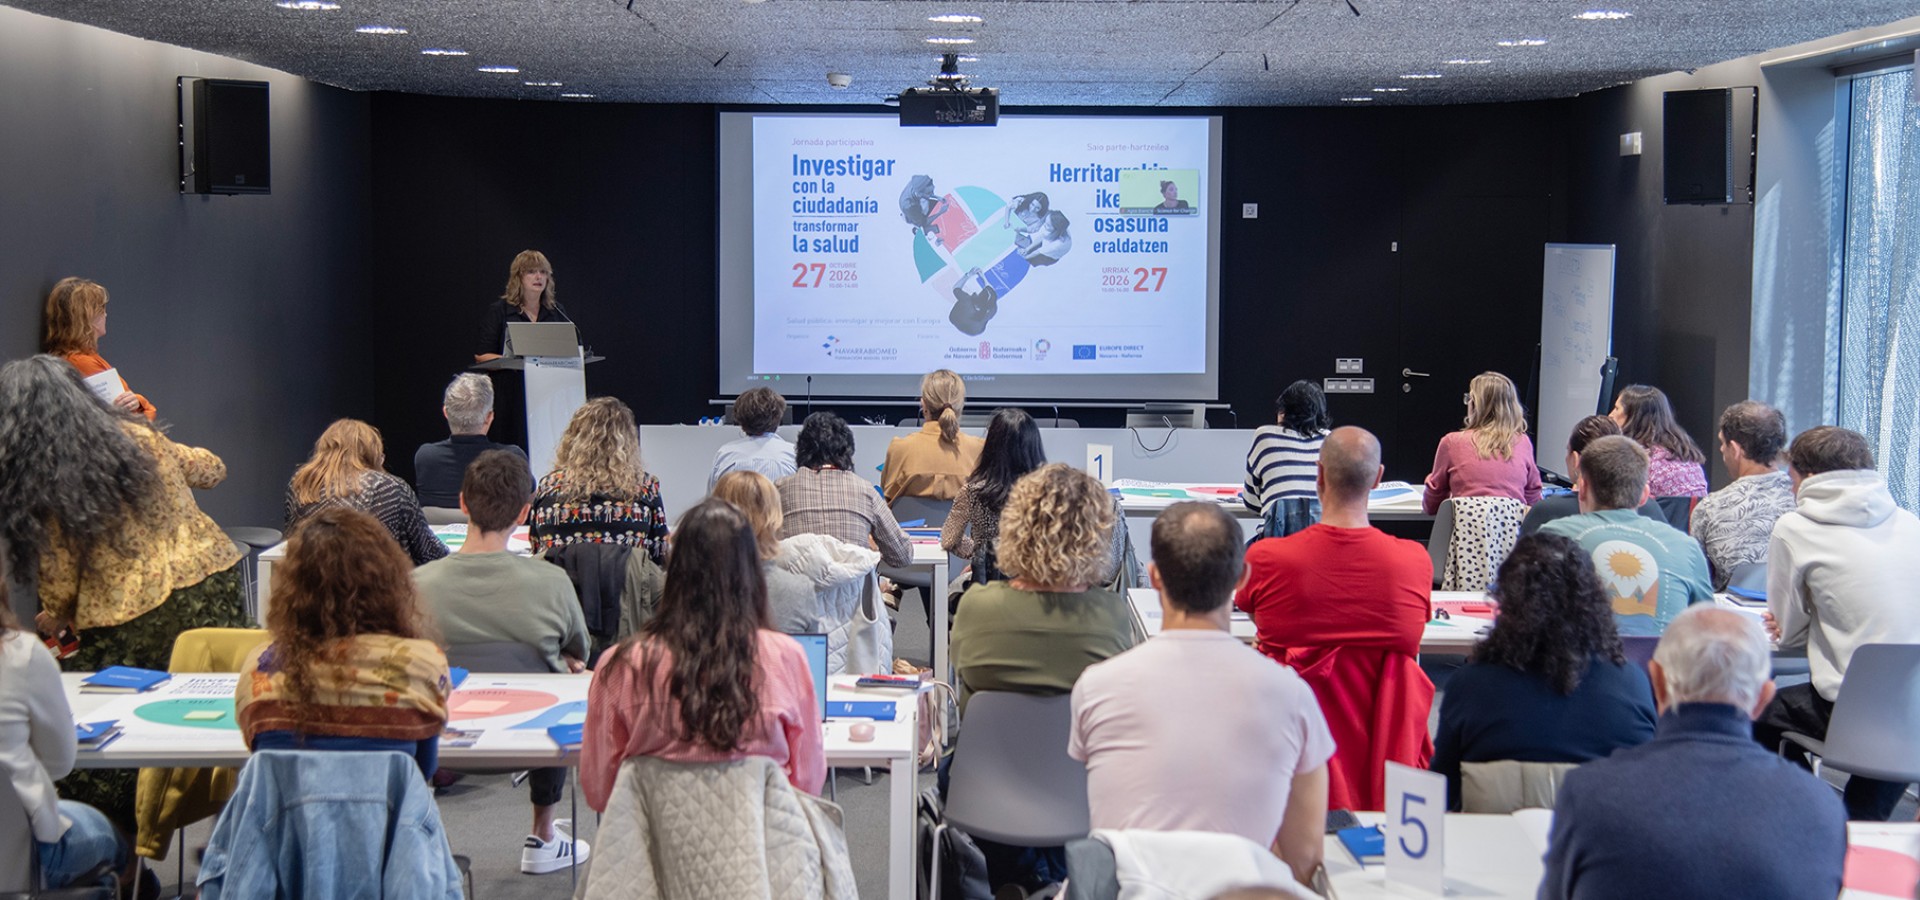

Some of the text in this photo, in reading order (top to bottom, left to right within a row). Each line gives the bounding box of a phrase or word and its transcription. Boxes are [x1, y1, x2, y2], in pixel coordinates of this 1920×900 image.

[792, 138, 874, 147] Jornada participativa
[1087, 143, 1104, 151] Saio
[793, 154, 895, 181] Investigar
[793, 178, 835, 193] con la
[793, 197, 878, 214] ciudadanía
[1096, 189, 1120, 208] ike
[793, 221, 859, 232] transformar
[1094, 217, 1168, 233] osasuna
[793, 235, 859, 253] la salud
[1094, 238, 1168, 253] eraldatzen
[792, 263, 826, 288] 27
[829, 271, 857, 281] 2026
[1102, 275, 1129, 286] 2026
[1133, 267, 1168, 292] 27
[1094, 454, 1103, 480] 1
[1398, 792, 1428, 859] 5
